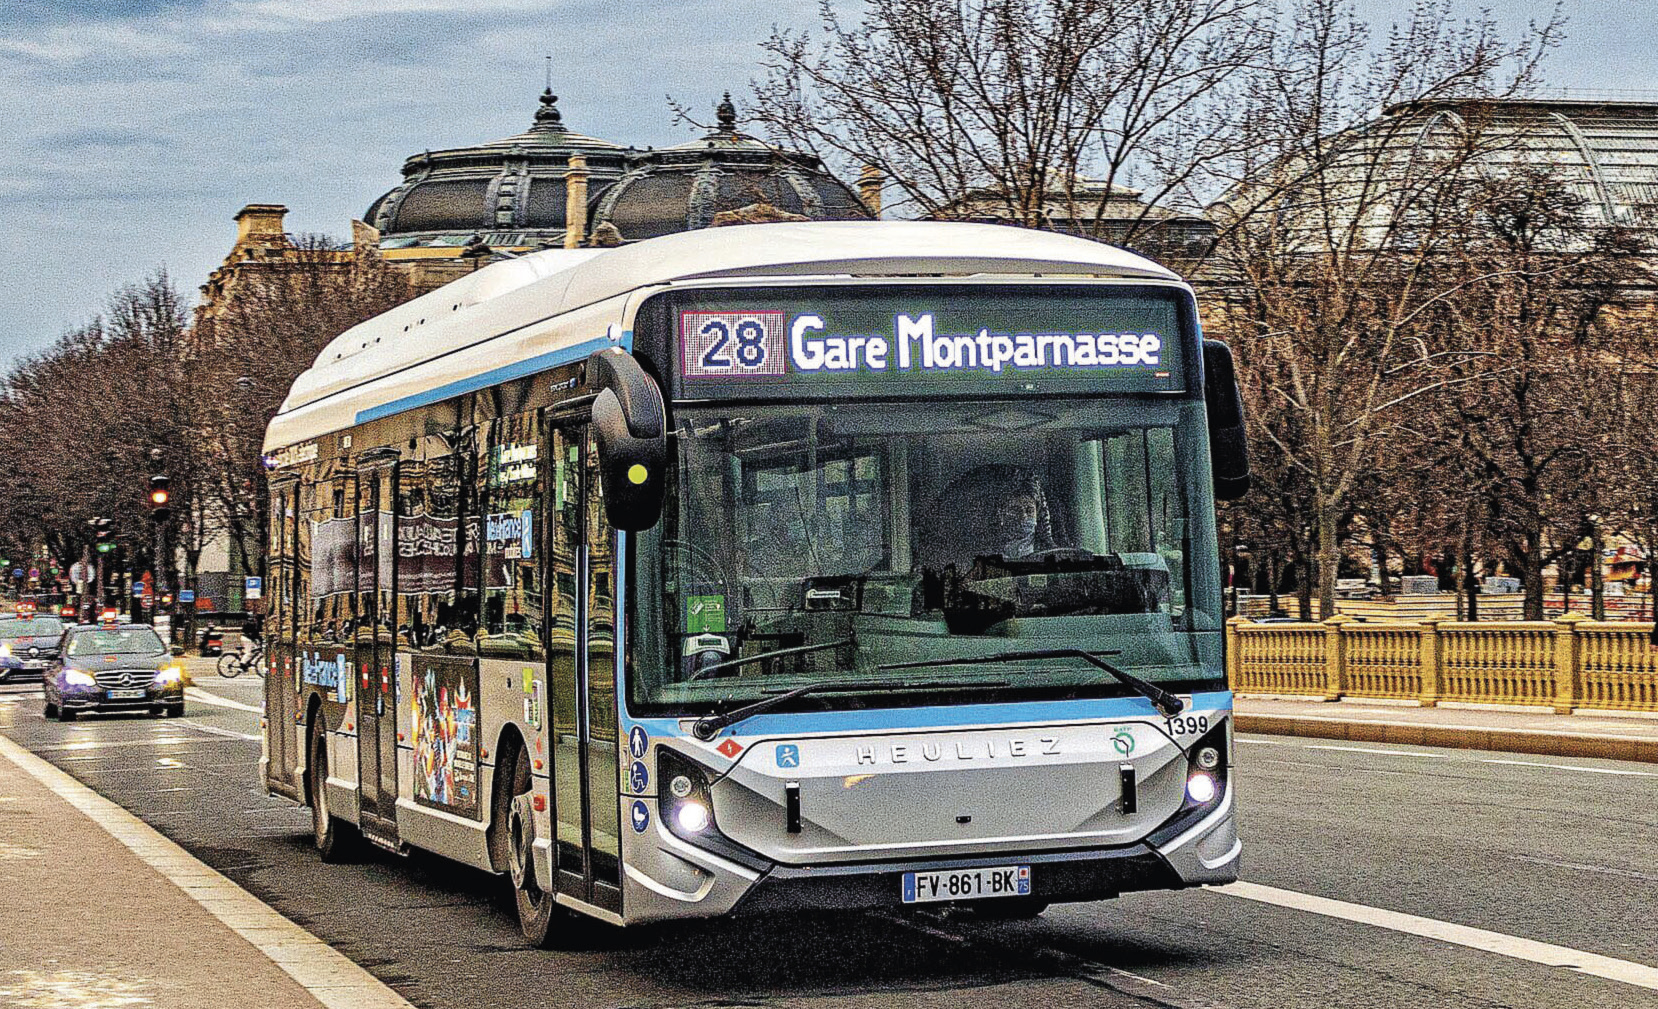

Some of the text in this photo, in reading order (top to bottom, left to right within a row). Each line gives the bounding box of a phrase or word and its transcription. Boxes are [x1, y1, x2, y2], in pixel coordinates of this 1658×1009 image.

[701, 320, 766, 368] 28
[791, 314, 1161, 372] Gare Montparnasse
[1163, 716, 1208, 736] 1399
[857, 738, 1061, 765] HEULIEZ
[916, 870, 1015, 898] FV-861-BK
[1018, 880, 1029, 892] 75
